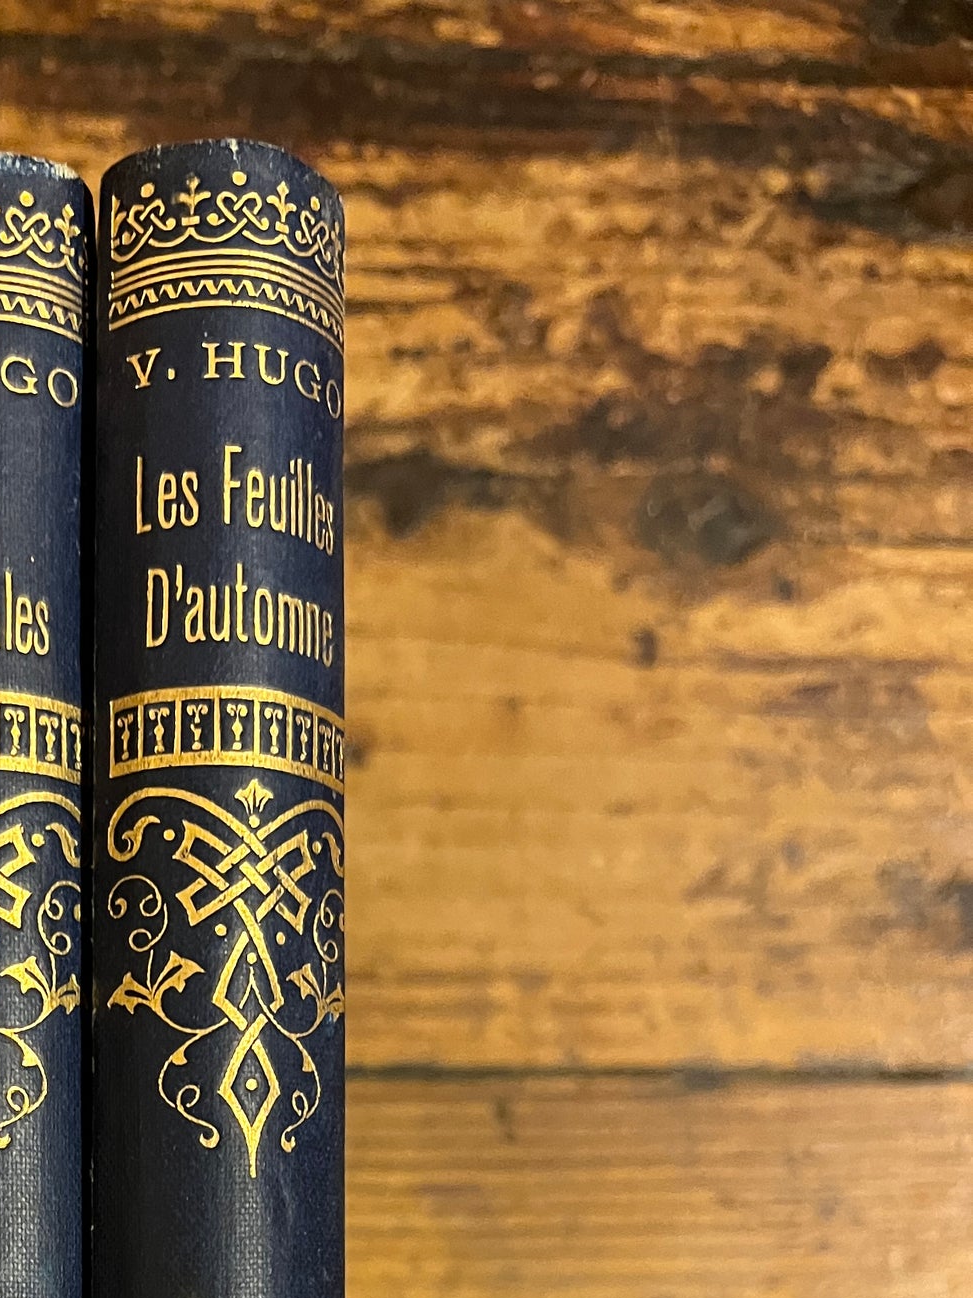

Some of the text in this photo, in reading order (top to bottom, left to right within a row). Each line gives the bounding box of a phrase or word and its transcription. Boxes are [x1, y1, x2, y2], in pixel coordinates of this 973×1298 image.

[126, 341, 341, 419] V. HUGO
[136, 445, 334, 556] Les Feuilles
[146, 562, 333, 667] D'automne
